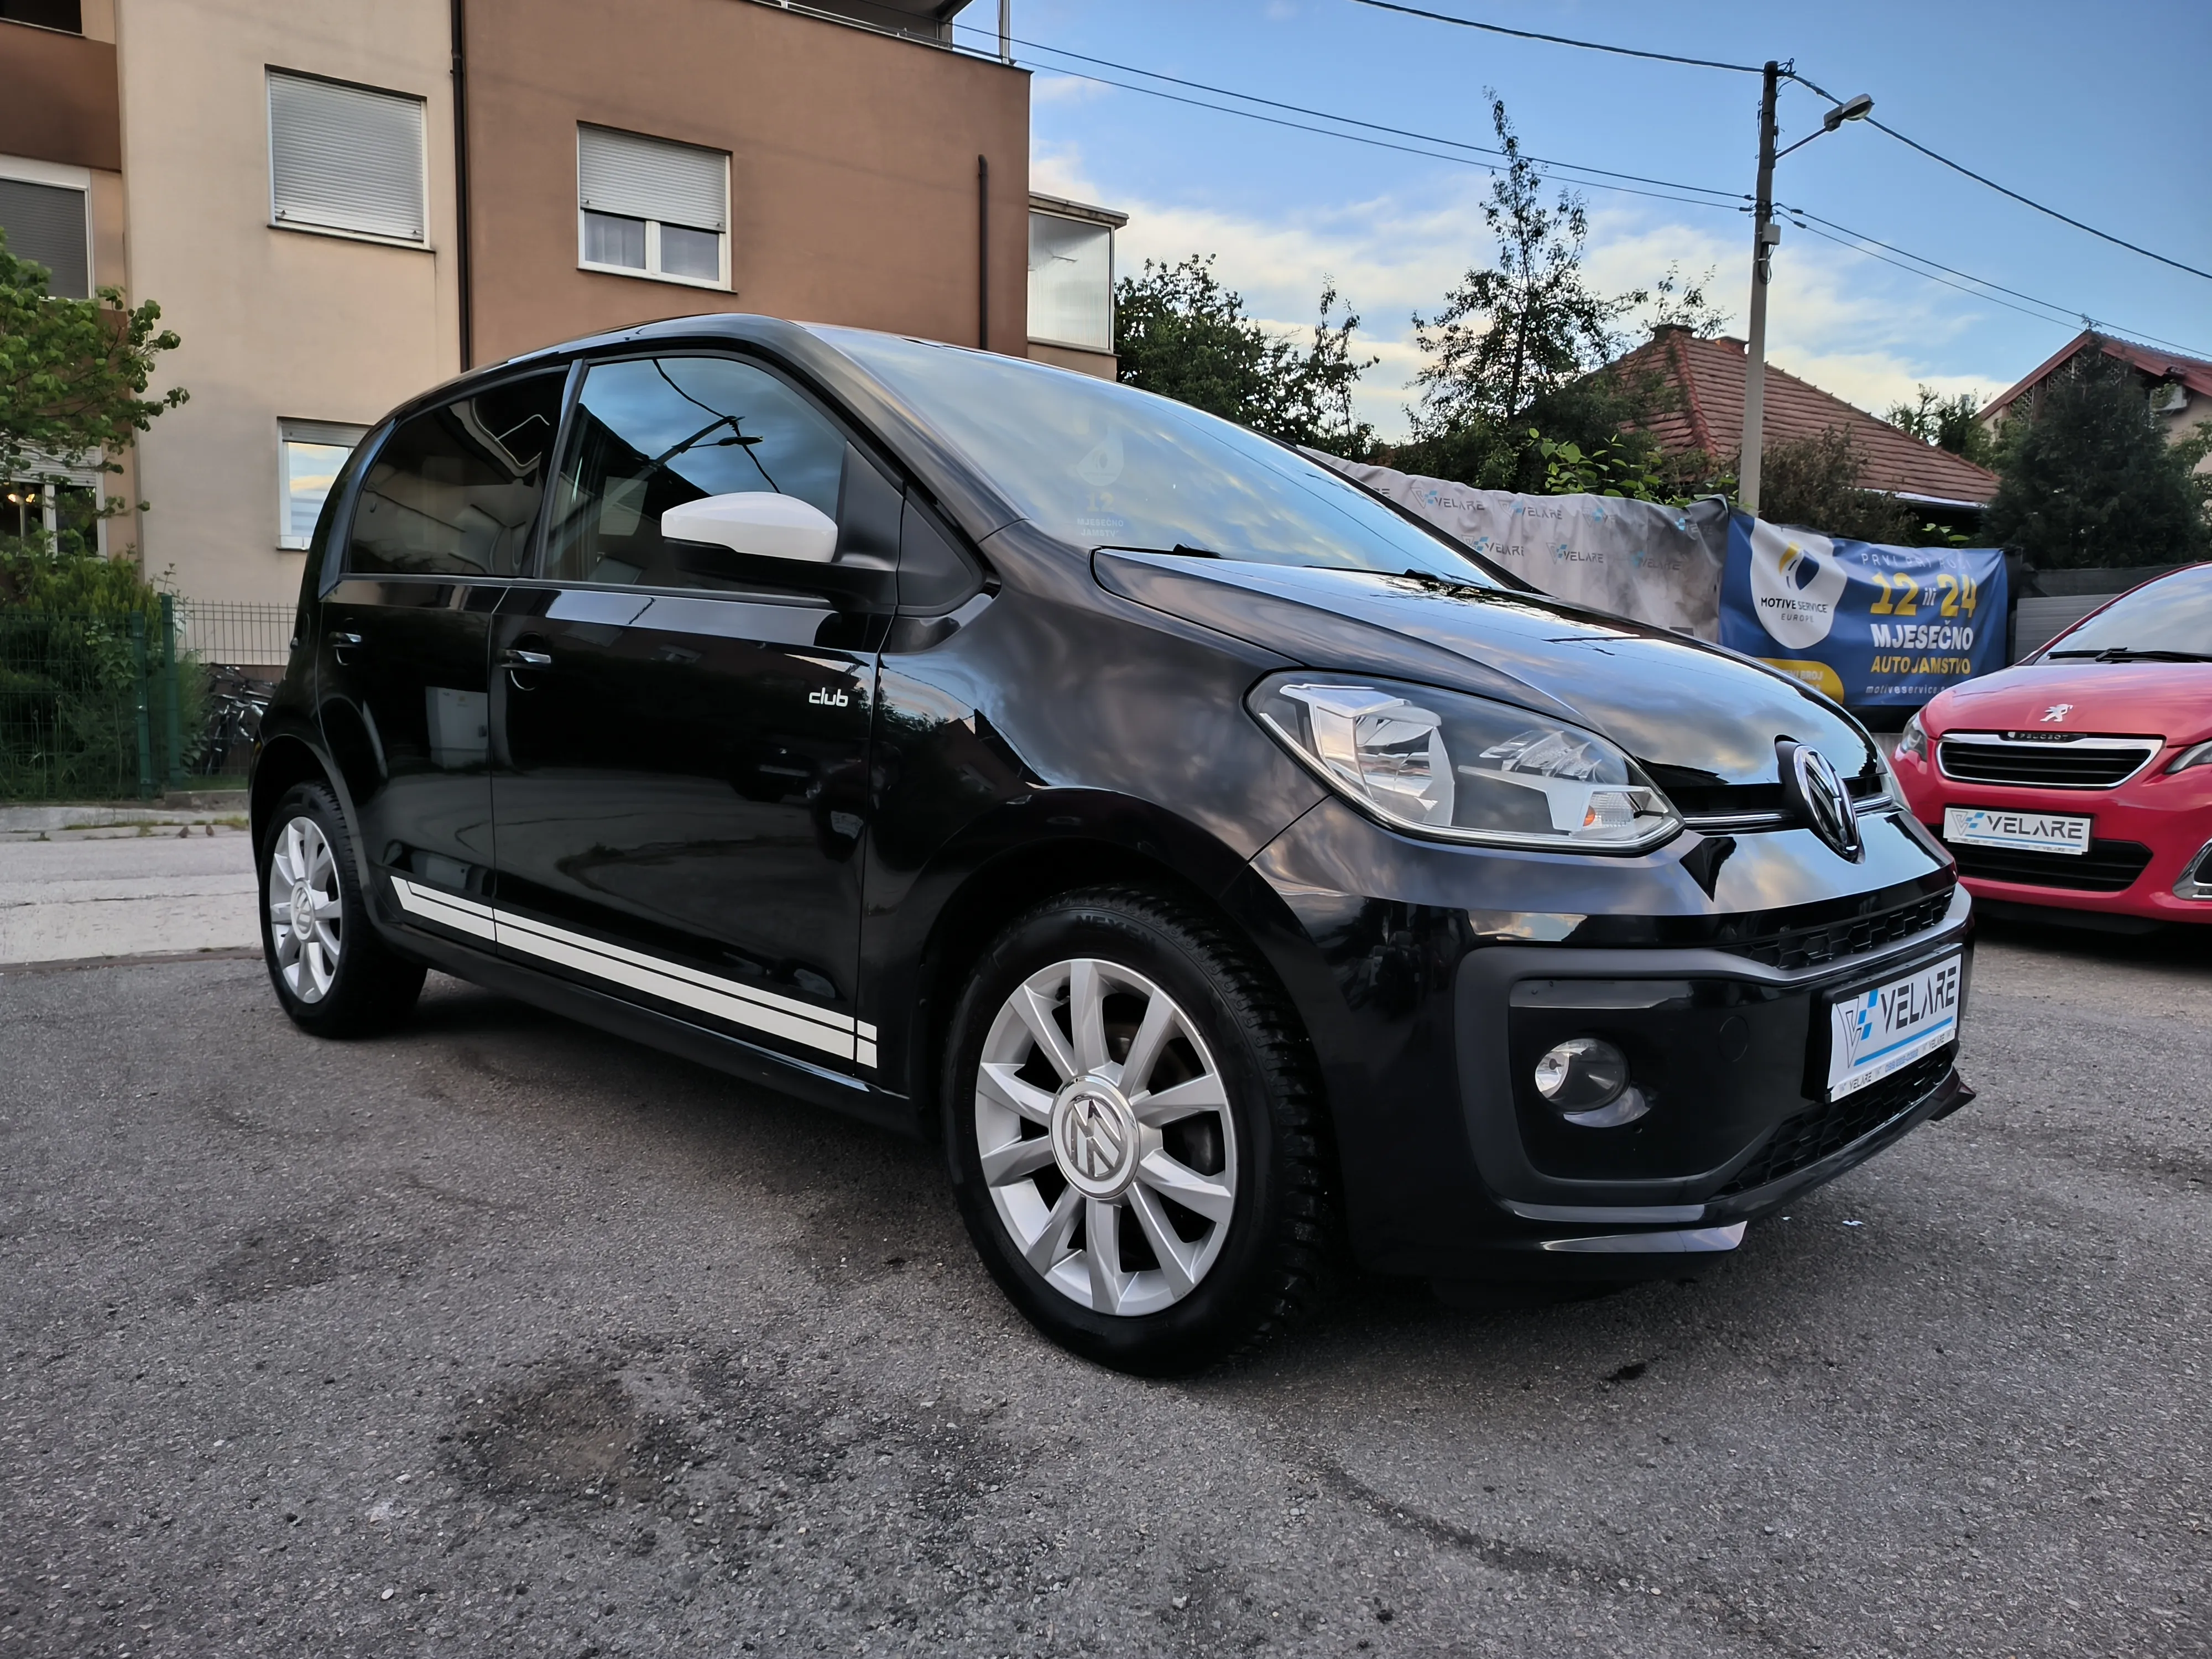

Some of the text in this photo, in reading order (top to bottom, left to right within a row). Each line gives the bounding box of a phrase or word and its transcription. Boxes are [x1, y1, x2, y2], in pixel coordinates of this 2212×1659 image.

[1434, 496, 1485, 511] VELARE
[1081, 528, 1120, 537] JAMSTV
[1563, 550, 1604, 563] VELARE
[1861, 553, 1898, 566] PRVI
[1870, 572, 1977, 618] 12 ili 24
[1761, 597, 1829, 613] MOTIVE SERVICE
[1781, 613, 1814, 623] EUROPE
[1870, 620, 1974, 651] MJESEČNO
[808, 687, 849, 707] club
[1986, 815, 2084, 839] VELARE
[1881, 966, 1957, 1034] VELARE
[1849, 1072, 1872, 1089] VELARE
